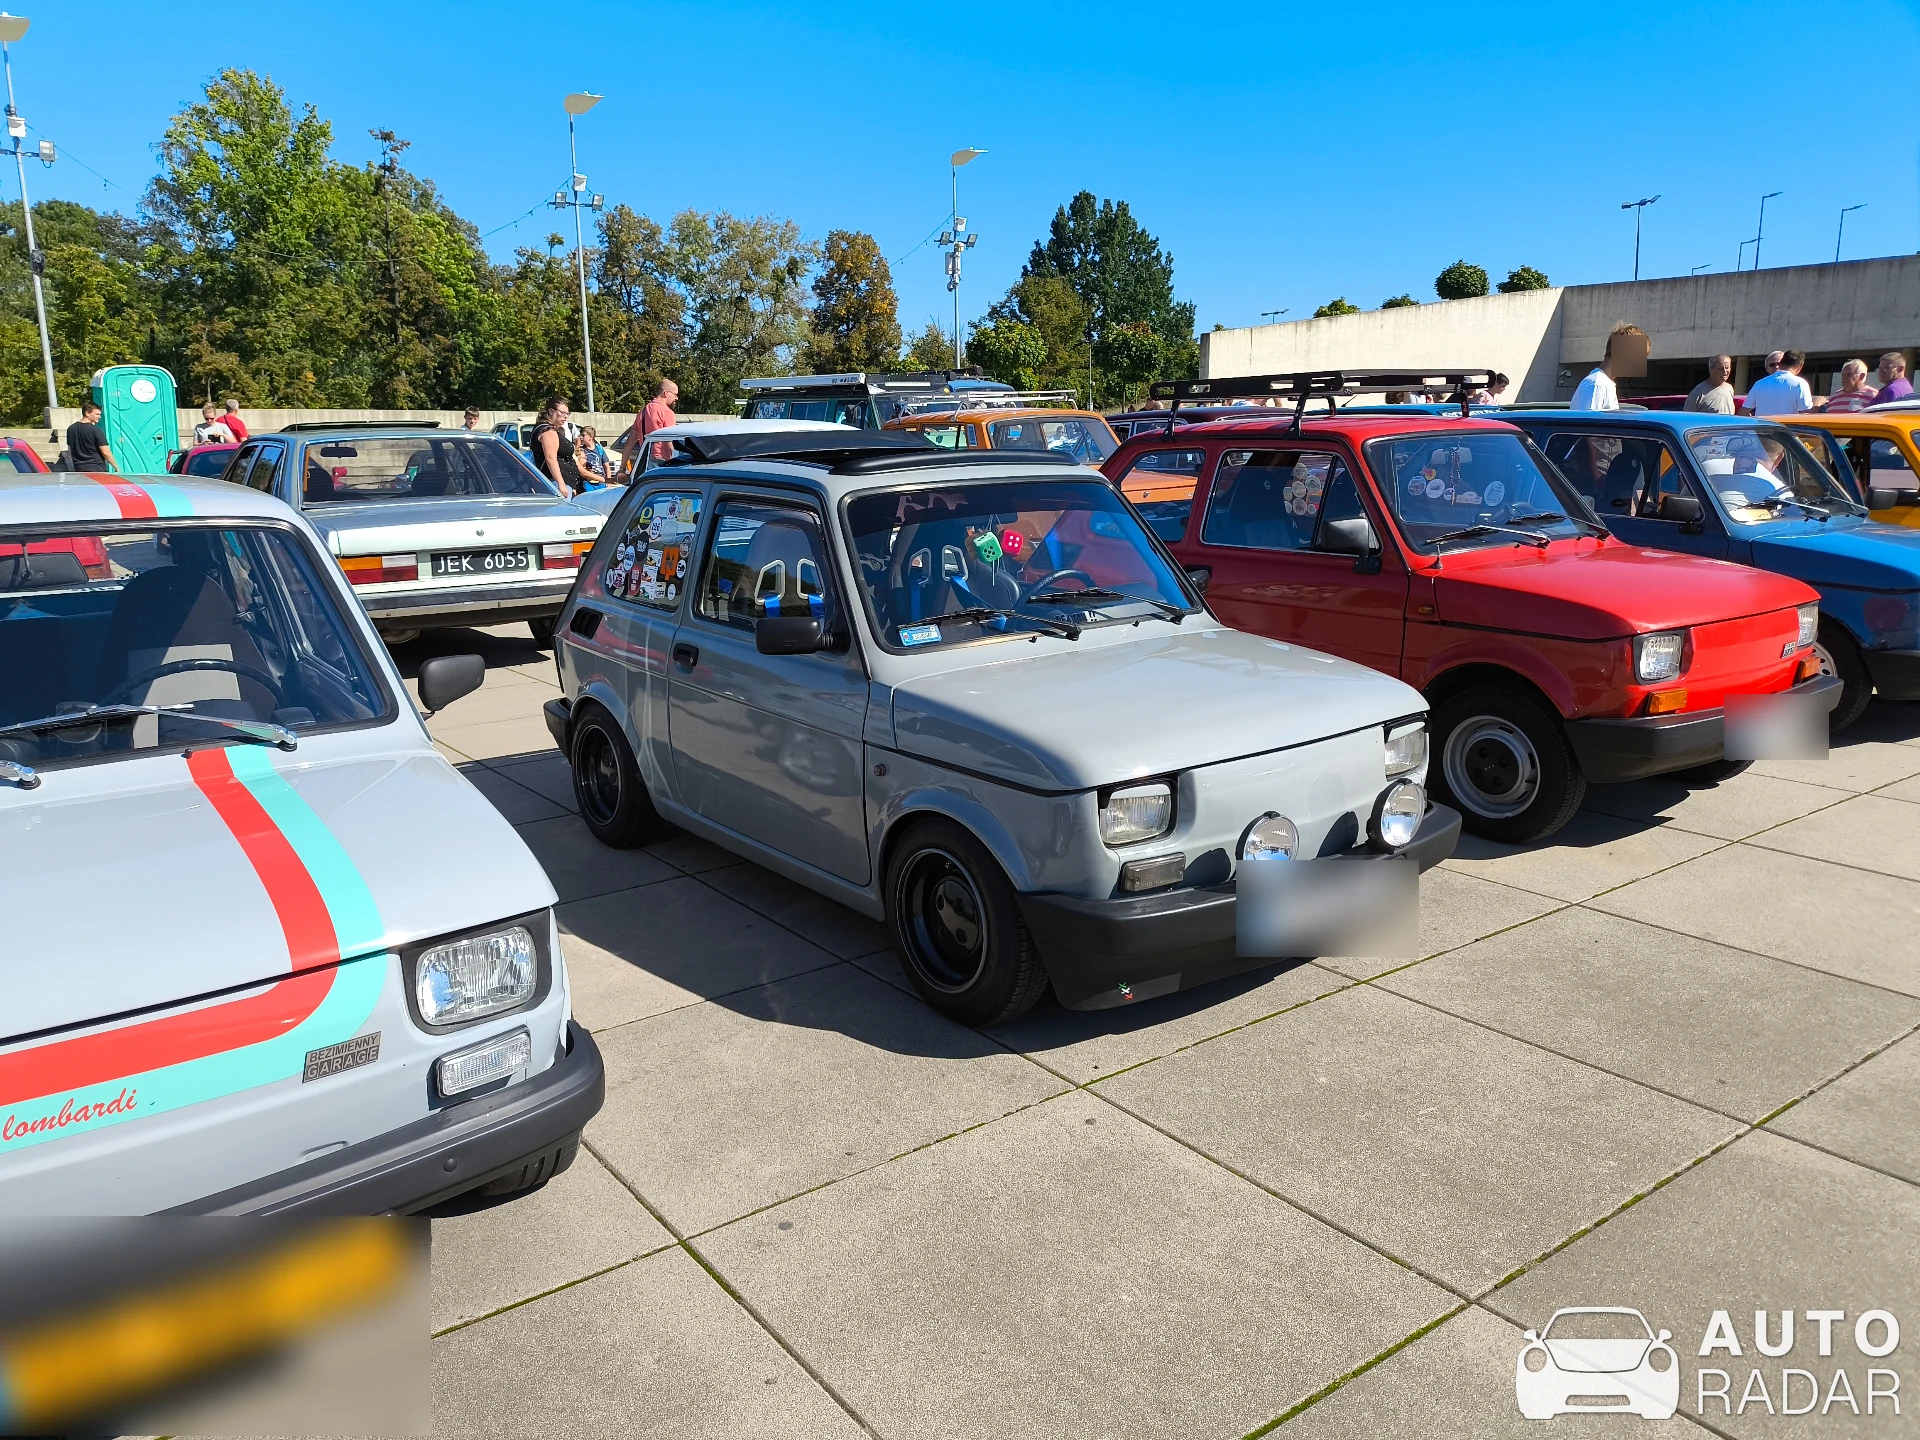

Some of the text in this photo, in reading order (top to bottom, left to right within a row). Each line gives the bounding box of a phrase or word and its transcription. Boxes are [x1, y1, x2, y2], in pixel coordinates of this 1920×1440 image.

[437, 551, 528, 573] JEK 6055
[307, 1046, 379, 1078] GARAGE
[309, 1034, 378, 1063] BEZIMIENNY
[2, 1087, 138, 1141] lombardi
